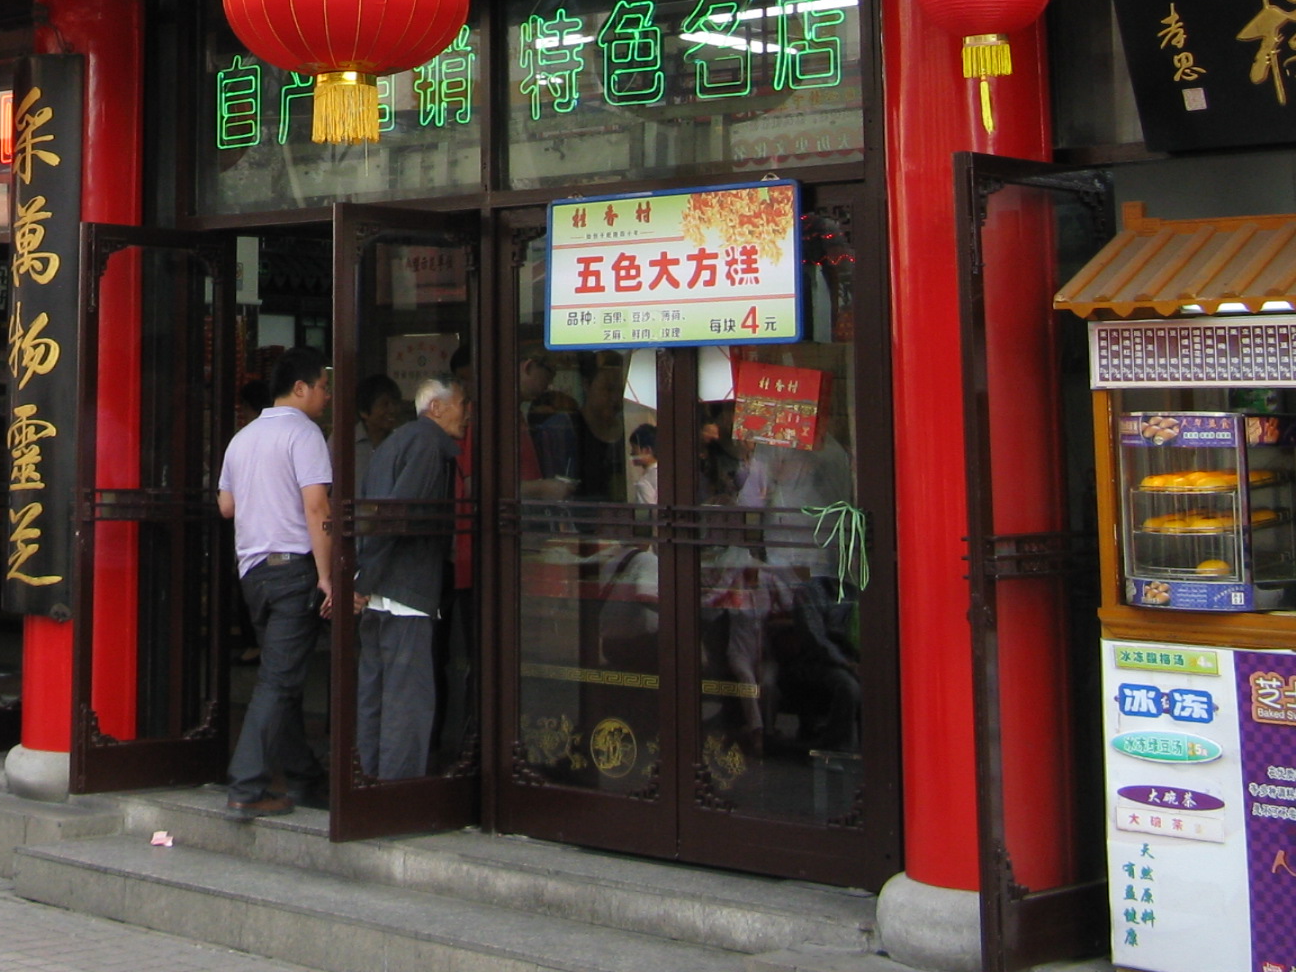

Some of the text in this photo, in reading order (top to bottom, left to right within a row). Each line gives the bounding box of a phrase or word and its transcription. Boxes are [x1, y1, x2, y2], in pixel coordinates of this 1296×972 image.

[574, 245, 760, 294] 五色大方糕
[1123, 688, 1208, 719] 冰冻
[1258, 707, 1285, 720] Baked
[1148, 788, 1197, 808] 大碗茶
